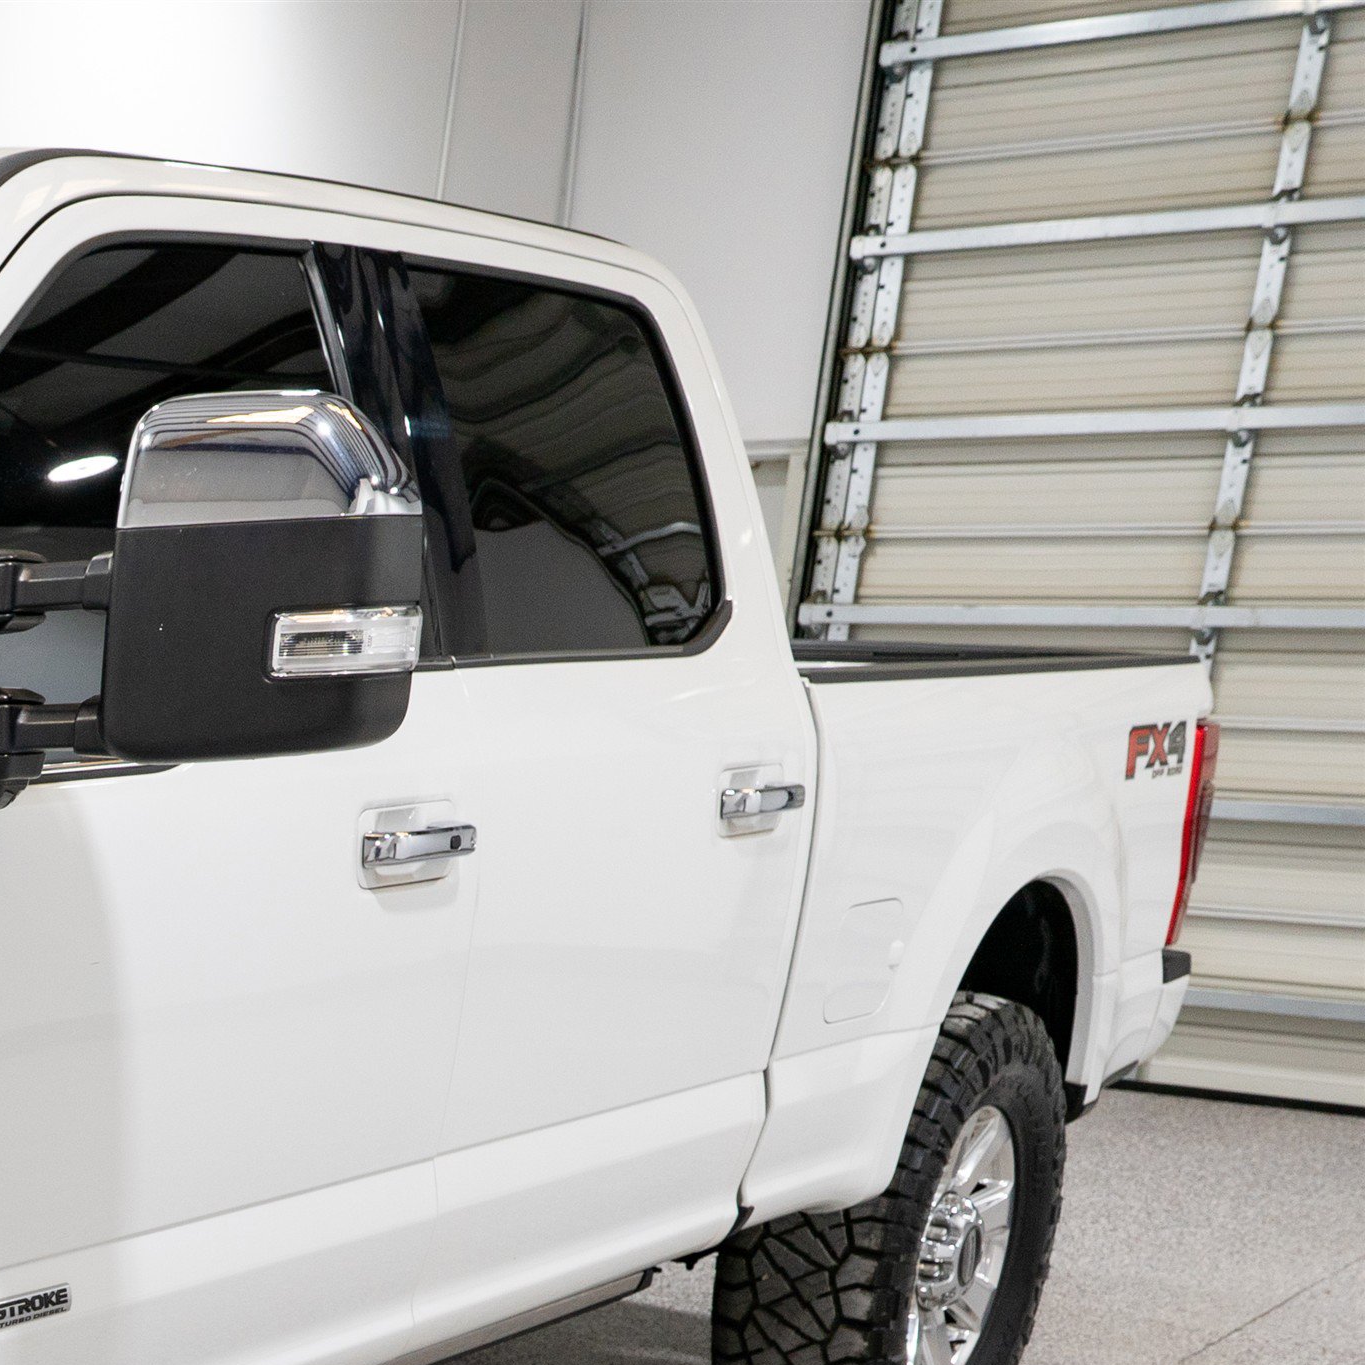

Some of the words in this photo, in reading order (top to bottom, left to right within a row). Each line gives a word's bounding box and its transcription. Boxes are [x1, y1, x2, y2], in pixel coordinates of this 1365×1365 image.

[1124, 720, 1187, 780] FX4
[0, 1315, 31, 1329] TURBO
[32, 1307, 67, 1320] DIESEL
